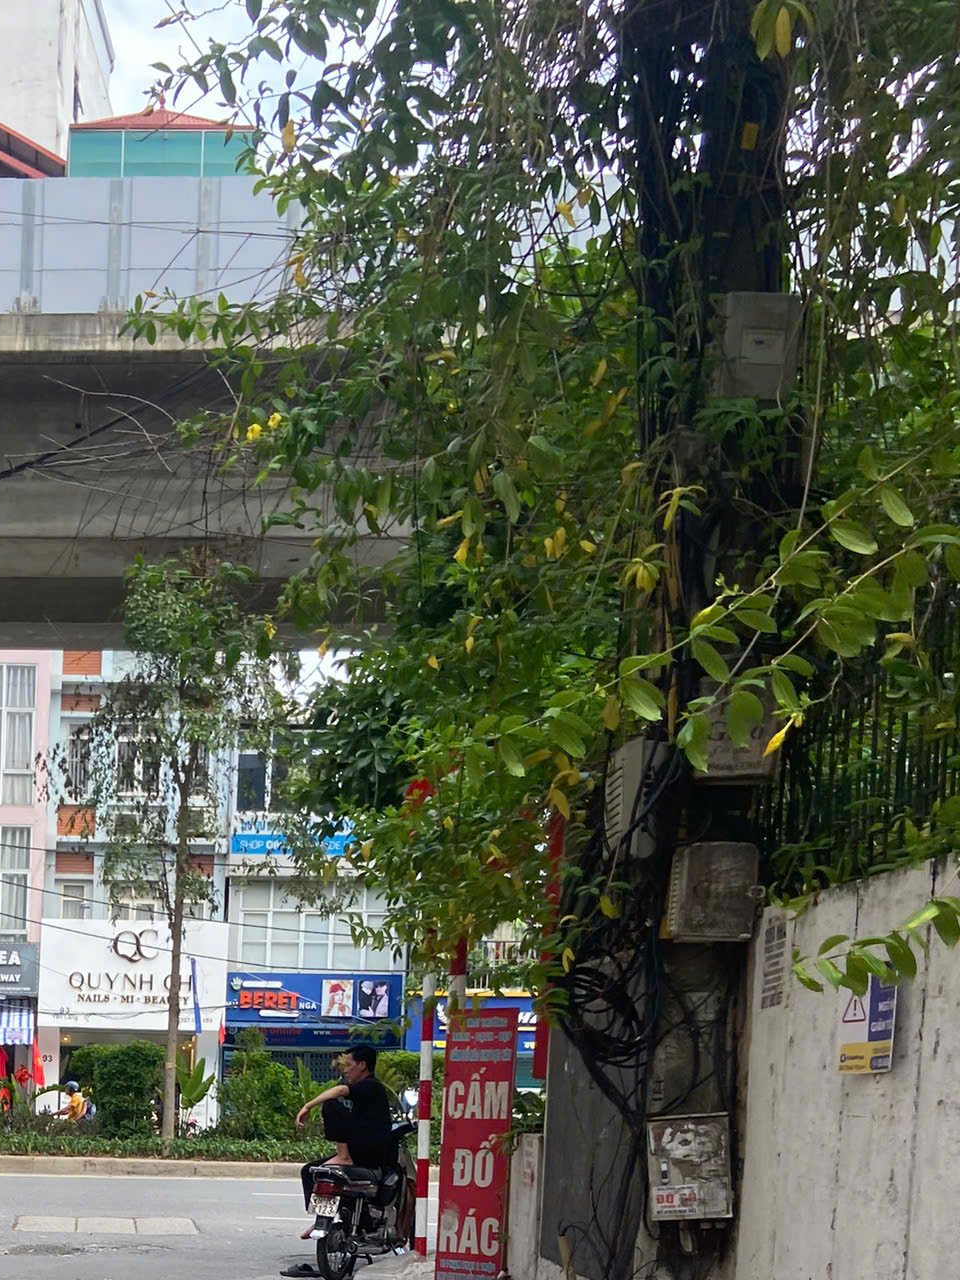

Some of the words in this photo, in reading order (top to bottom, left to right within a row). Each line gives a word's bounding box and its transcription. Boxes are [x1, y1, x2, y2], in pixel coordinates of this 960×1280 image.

[77, 994, 110, 1003] NAILS
[120, 995, 134, 1003] MI
[240, 992, 300, 1010] BERET
[299, 1002, 317, 1010] NGA
[42, 1055, 53, 1063] 93
[447, 1067, 509, 1120] CẤM
[453, 1134, 497, 1188] ĐỔ
[439, 1208, 500, 1257] RÁC
